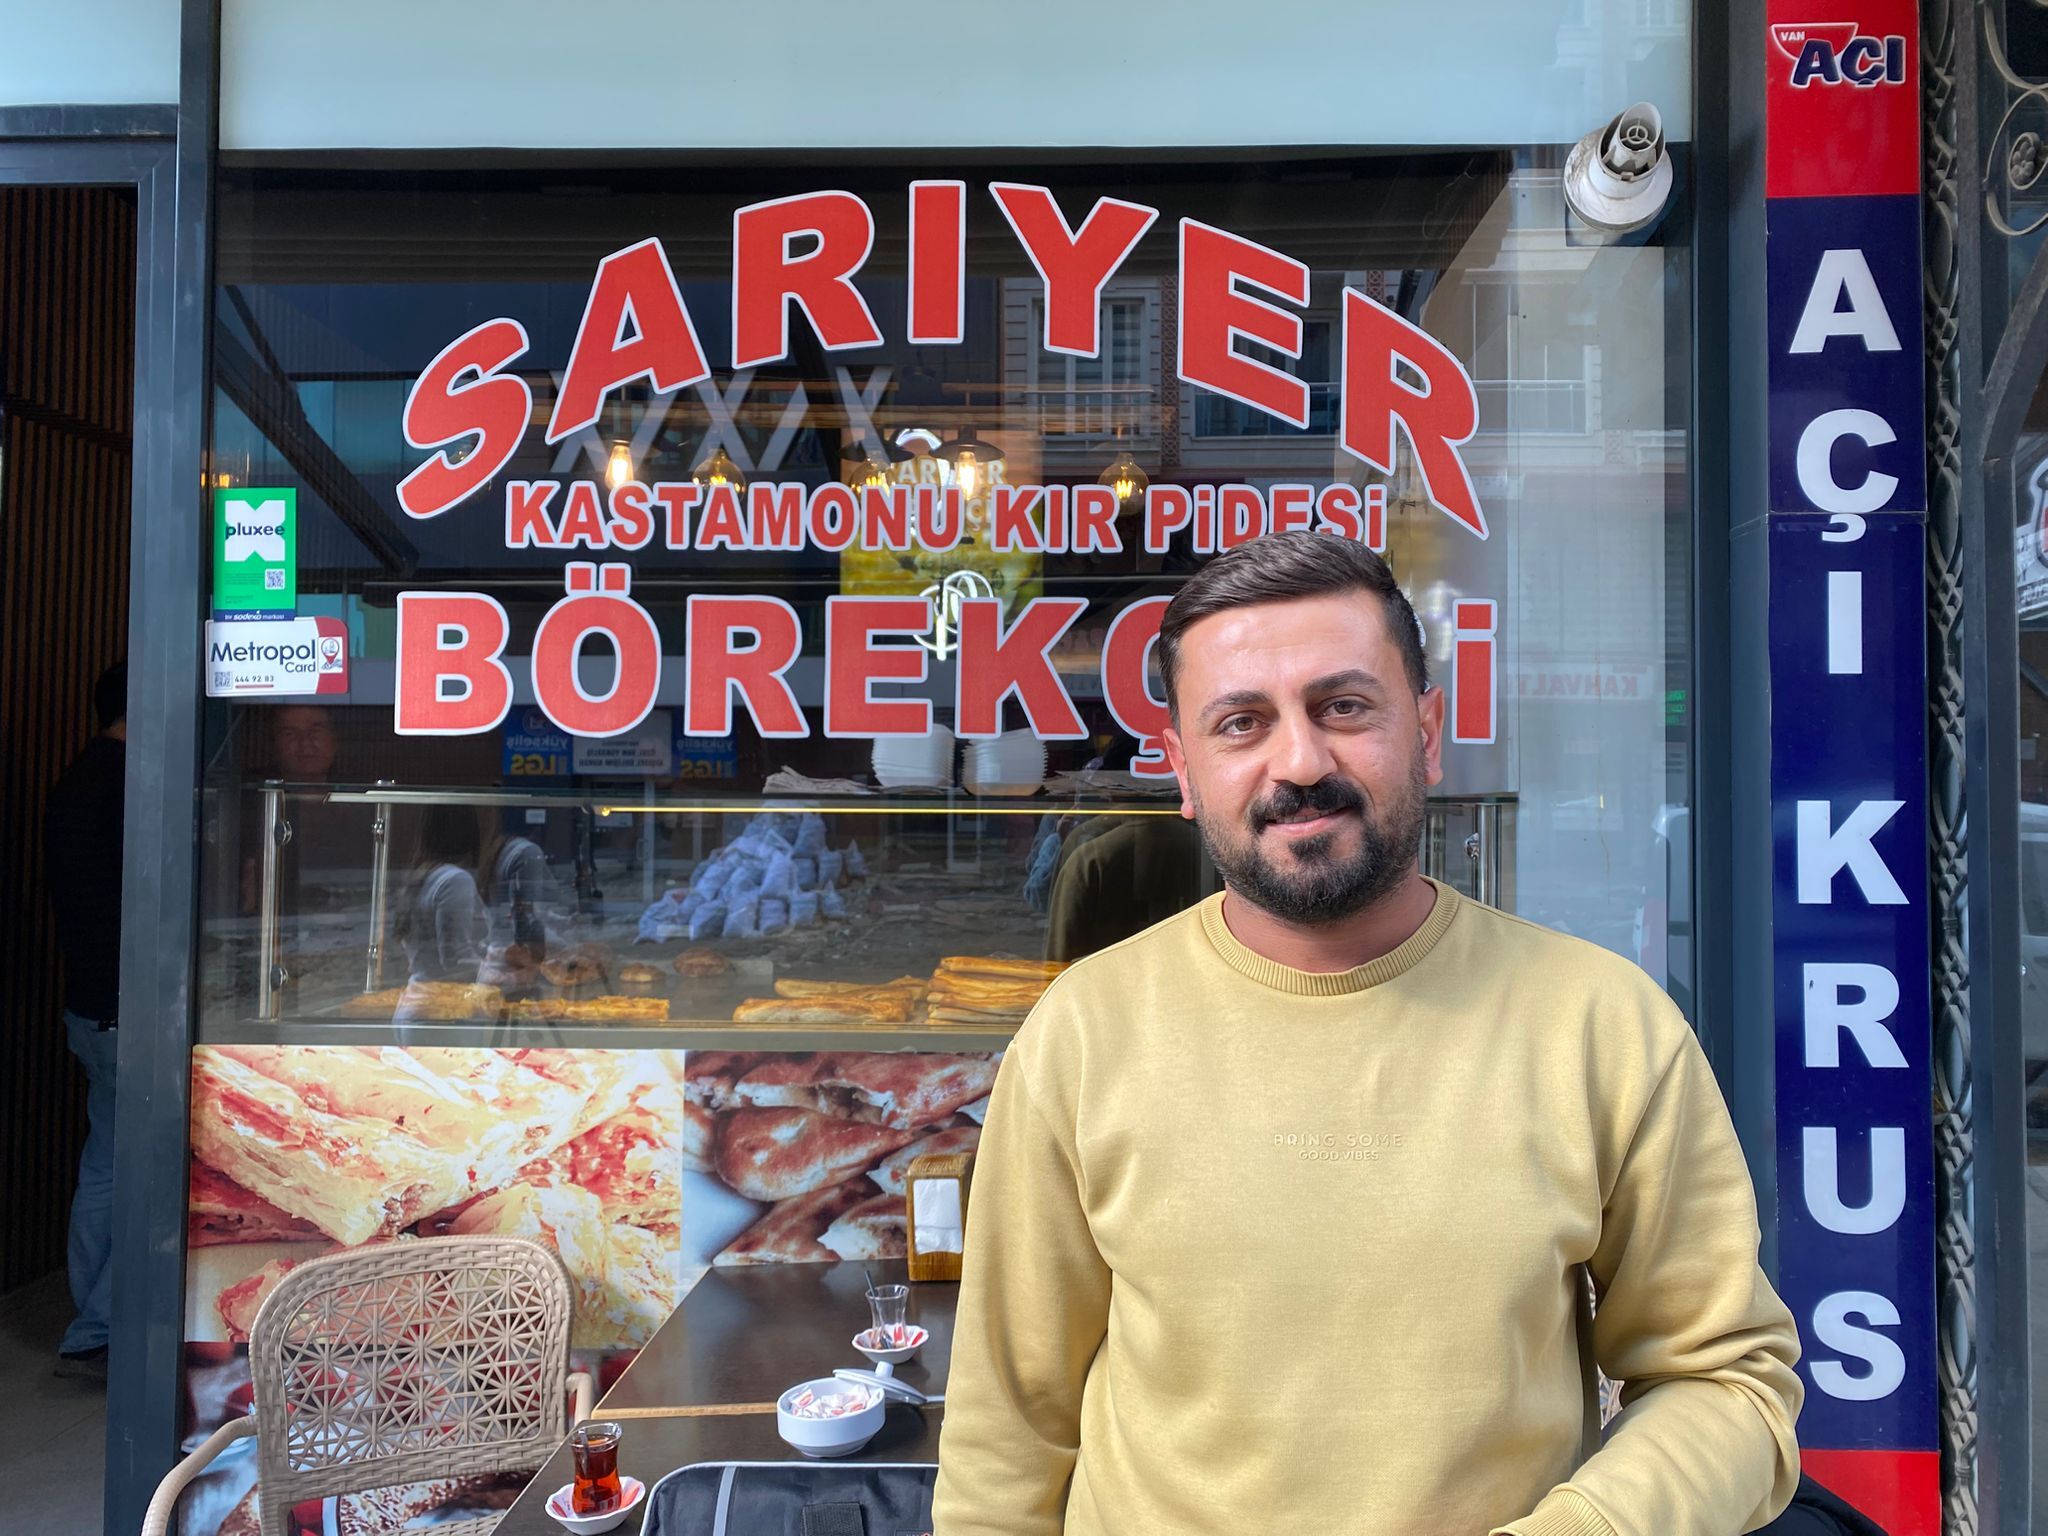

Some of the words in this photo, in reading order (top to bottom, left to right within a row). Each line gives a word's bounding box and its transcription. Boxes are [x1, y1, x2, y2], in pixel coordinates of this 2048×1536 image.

[1780, 31, 1806, 41] VAN
[1790, 35, 1907, 88] AÇI
[396, 179, 1490, 541] SARIYER
[505, 480, 966, 552] KASTAMONU
[990, 483, 1124, 553] KIR
[225, 523, 286, 540] pluxee
[210, 639, 317, 666] Metropol
[284, 660, 317, 673] Card
[234, 675, 251, 683] 444
[252, 675, 262, 683] 92
[1274, 1133, 1336, 1148] BRING
[1346, 1133, 1404, 1148] SOME
[1298, 1150, 1340, 1161] GOOD
[1343, 1150, 1380, 1161] VIBES
